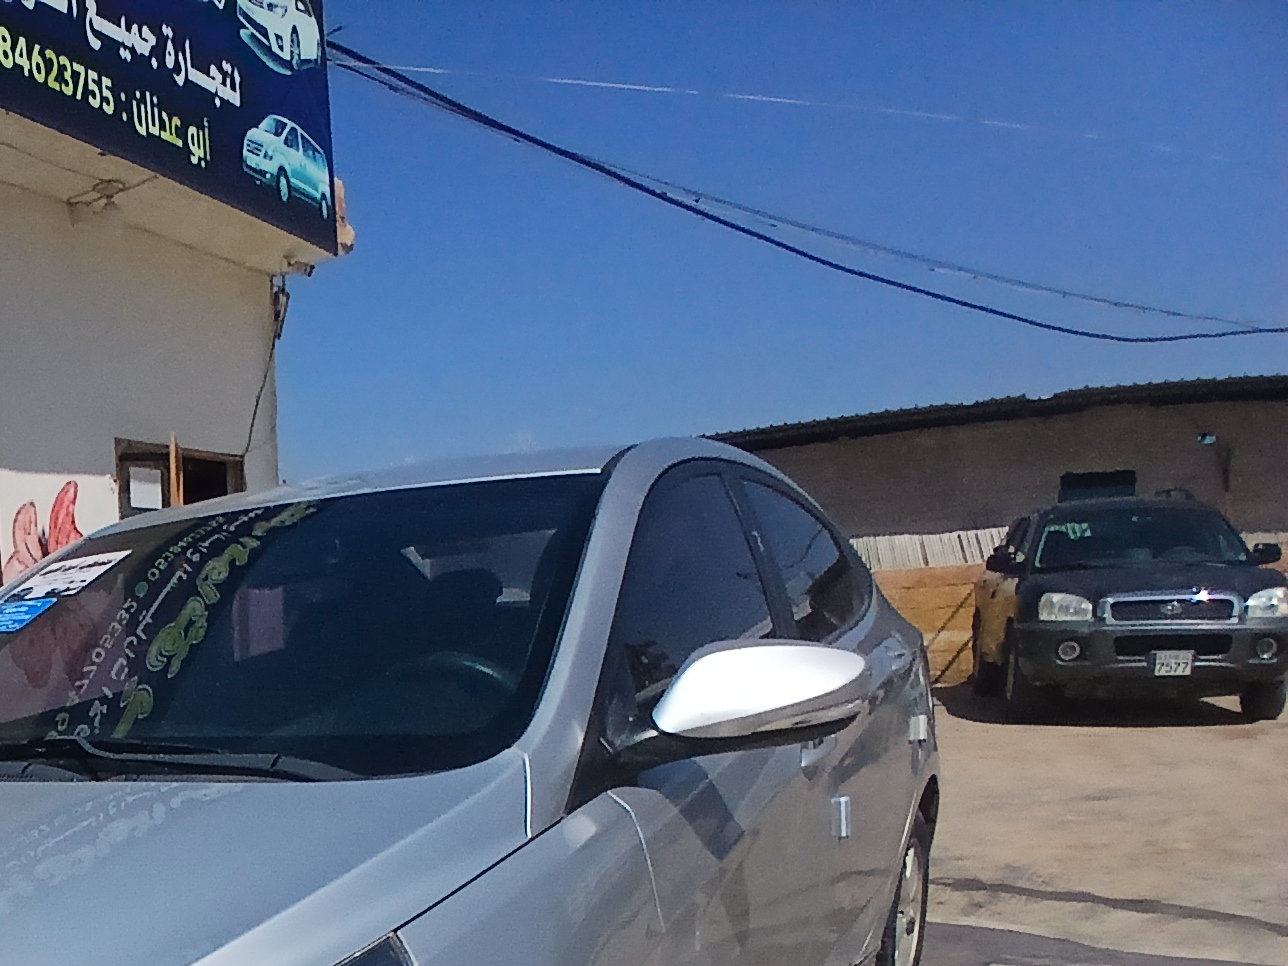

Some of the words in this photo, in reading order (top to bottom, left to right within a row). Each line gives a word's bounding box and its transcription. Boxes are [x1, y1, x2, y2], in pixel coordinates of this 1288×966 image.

[84, 0, 158, 70] جميع
[161, 22, 242, 108] لتجارة
[132, 90, 184, 148] عدنان
[1157, 661, 1189, 674] 7577
